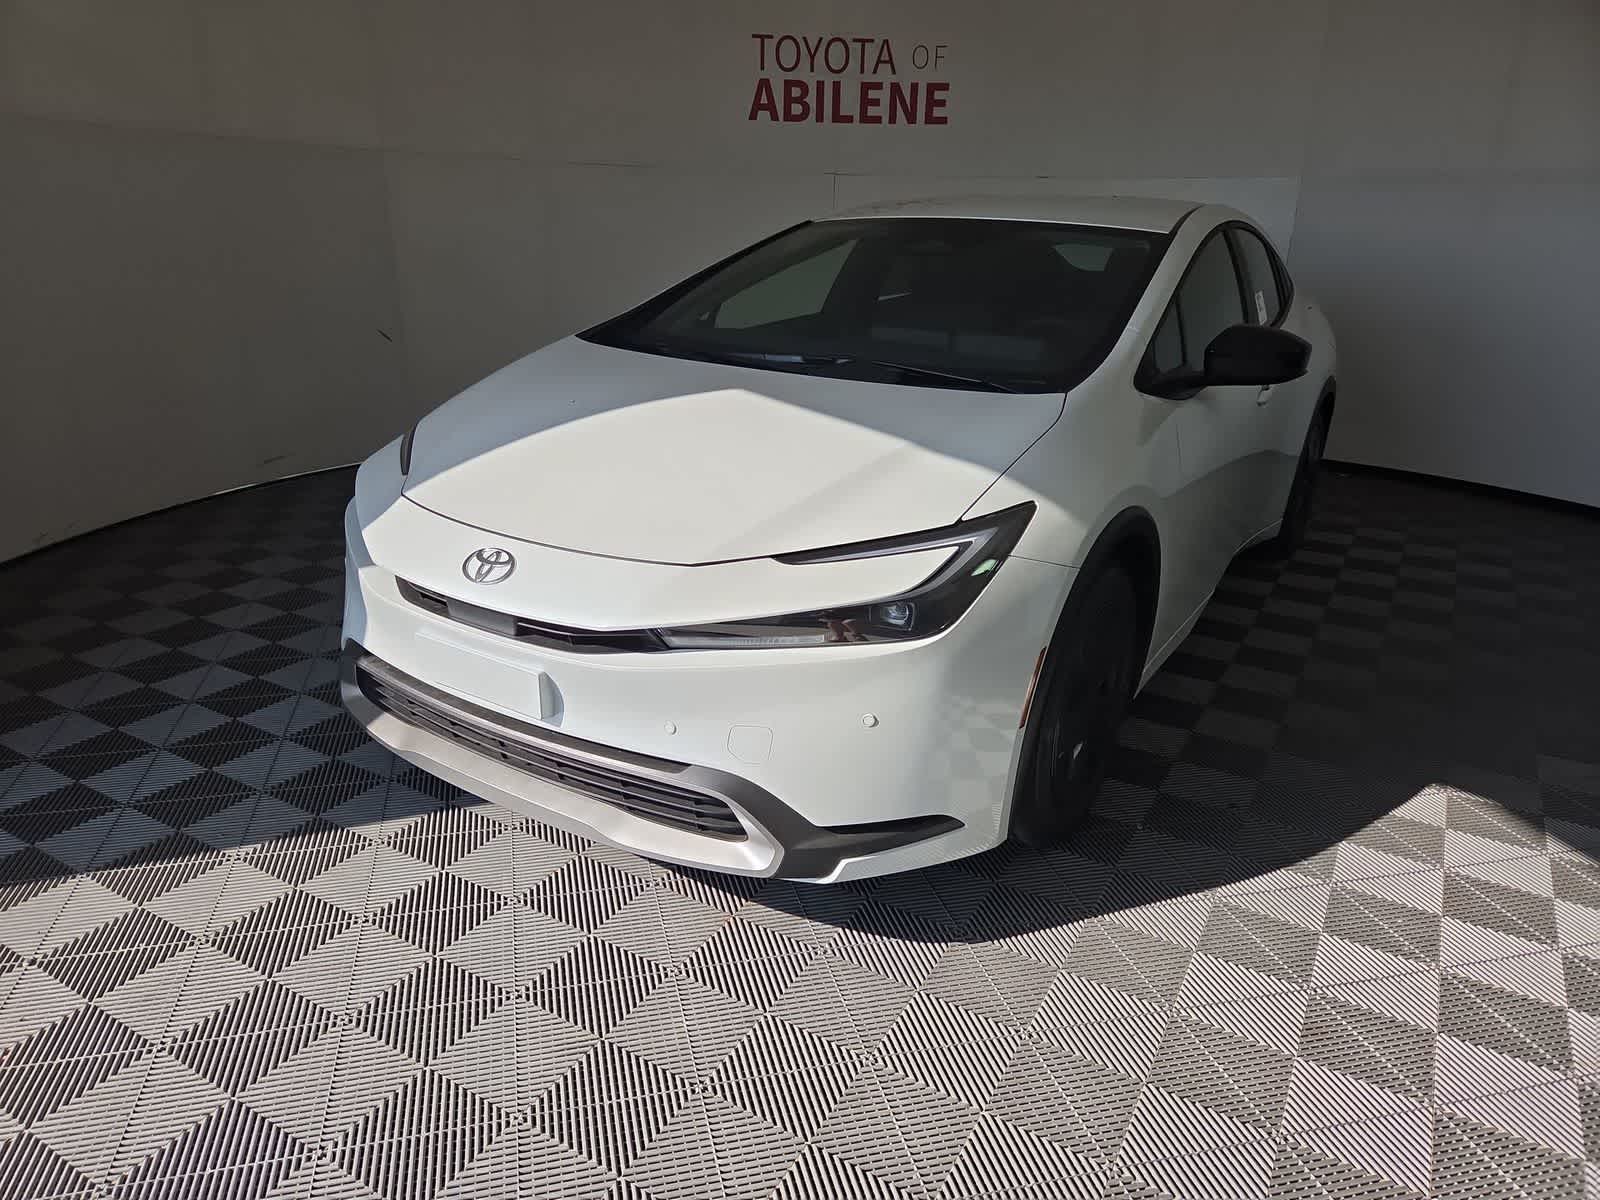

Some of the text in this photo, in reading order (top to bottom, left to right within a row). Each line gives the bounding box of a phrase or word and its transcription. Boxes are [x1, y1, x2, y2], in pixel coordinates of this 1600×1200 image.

[752, 34, 948, 75] TOYOTA OF
[749, 78, 950, 125] ABILENE
